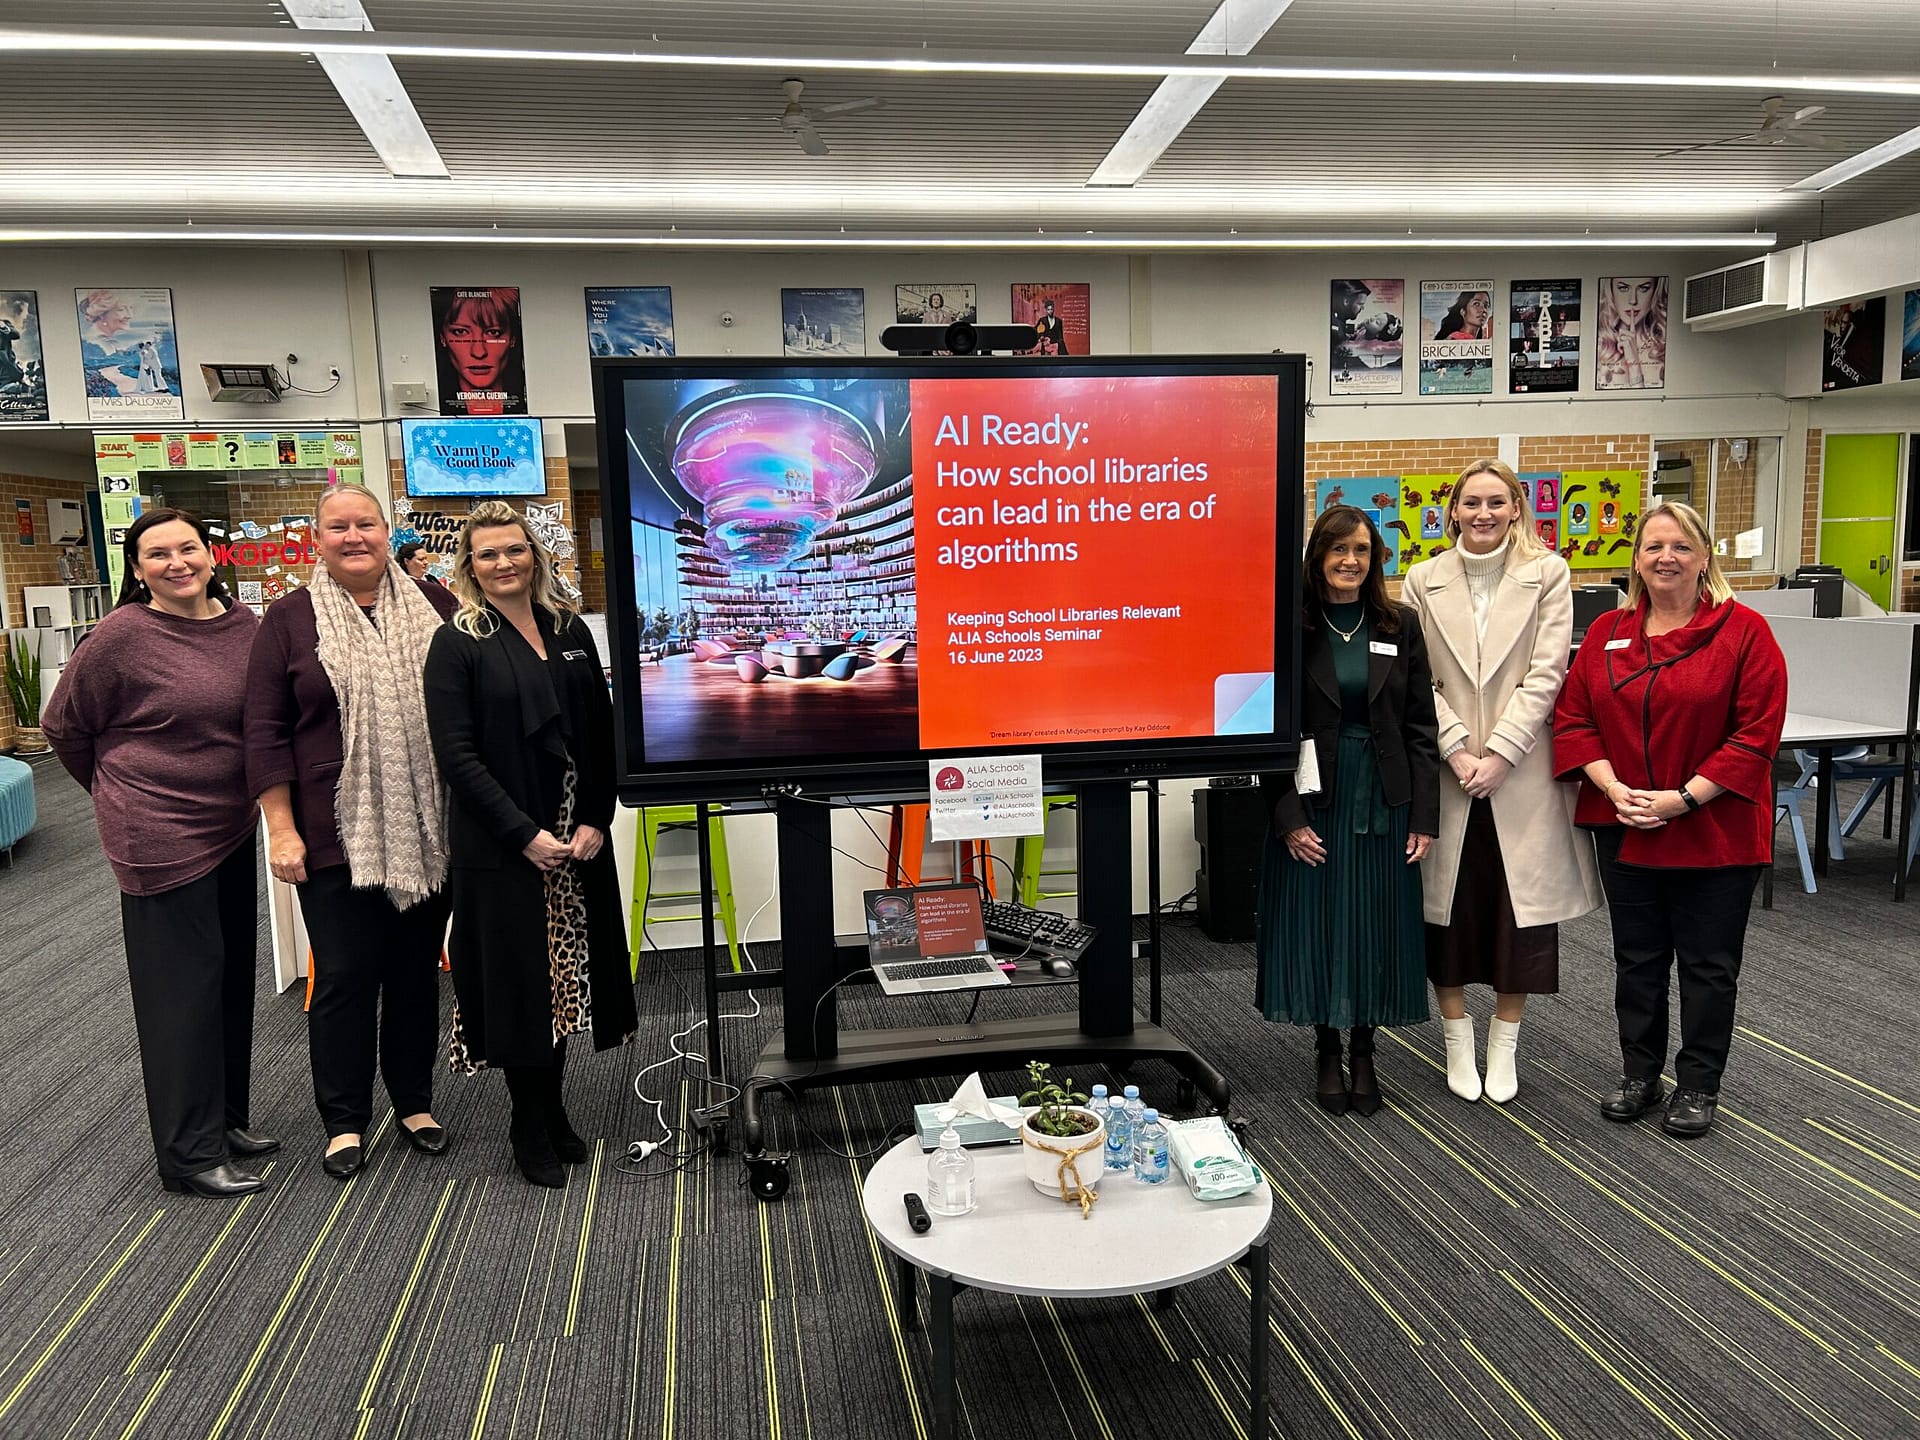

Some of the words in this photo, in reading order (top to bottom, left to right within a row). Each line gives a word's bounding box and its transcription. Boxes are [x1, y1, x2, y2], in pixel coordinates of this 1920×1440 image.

[1538, 291, 1552, 369] BABEL
[1422, 346, 1456, 358] BRICK
[1460, 345, 1491, 357] LANE
[125, 396, 174, 407] DALLOWAY
[456, 391, 486, 400] VERONICA
[486, 391, 508, 400] GUERIN
[333, 434, 357, 442] ROLL
[934, 415, 969, 446] AI
[982, 413, 1090, 450] Ready:
[100, 443, 129, 452] START
[434, 445, 479, 456] Warm
[480, 445, 500, 459] Up
[332, 458, 360, 466] AGAIN
[446, 456, 480, 468] Good
[482, 456, 516, 468] Book
[937, 461, 1002, 487] How
[1009, 458, 1096, 486] school
[1104, 456, 1208, 484] libraries
[937, 506, 984, 526] can
[993, 499, 1047, 525] lead
[1056, 498, 1080, 523] in
[1088, 496, 1132, 522] the
[1140, 500, 1181, 521] era
[1189, 494, 1217, 519] of
[421, 533, 459, 554] Wit
[937, 537, 1079, 570] algorithms
[947, 612, 1004, 628] Keeping
[1008, 608, 1056, 625] School
[1059, 606, 1119, 623] Libraries
[1122, 604, 1182, 620] Relevant
[947, 631, 982, 646] ALIA
[985, 628, 1041, 644] Schools
[1044, 626, 1102, 642] Seminar
[948, 651, 967, 665] 16
[970, 650, 1005, 665] June
[1008, 648, 1043, 663] 2023
[1034, 729, 1058, 737] created
[1102, 726, 1125, 735] prompt
[1125, 725, 1133, 733] by
[1134, 724, 1146, 732] Kay
[1146, 723, 1171, 732] Oddone
[967, 765, 988, 775] ALIA
[989, 763, 1025, 774] Schools
[967, 779, 996, 789] Social
[997, 777, 1028, 787] Media
[1211, 1173, 1225, 1182] 100
